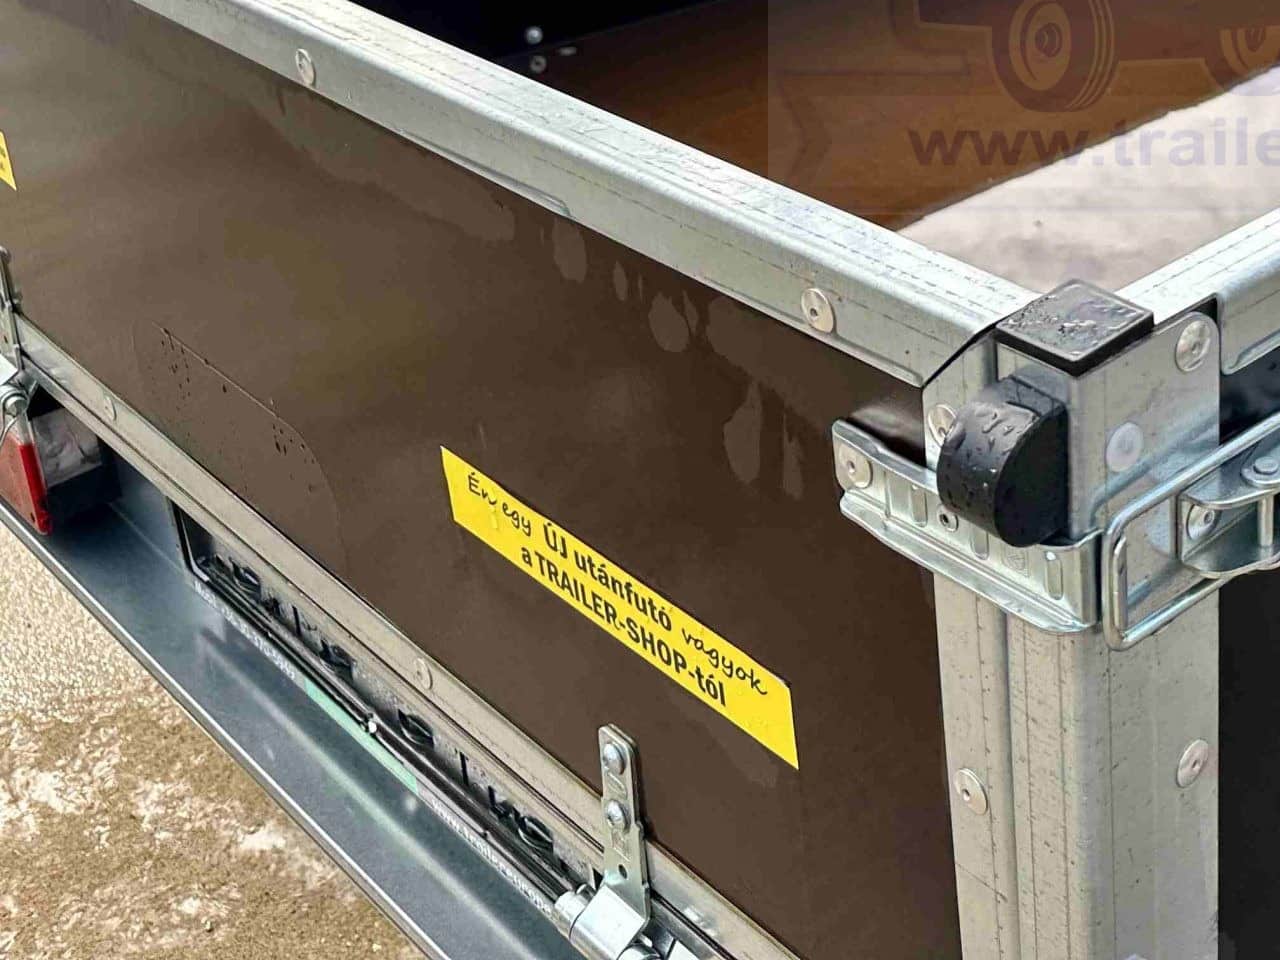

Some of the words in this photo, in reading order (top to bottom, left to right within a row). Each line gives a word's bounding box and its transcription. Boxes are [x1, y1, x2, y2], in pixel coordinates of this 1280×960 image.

[467, 472, 497, 506] Én
[502, 501, 532, 537] egy
[543, 522, 567, 559] ÚJ
[574, 547, 672, 631] utánfutó
[681, 628, 767, 696] vagyok
[521, 546, 533, 567] a
[534, 552, 726, 707] TRAILER-SHOP-tól
